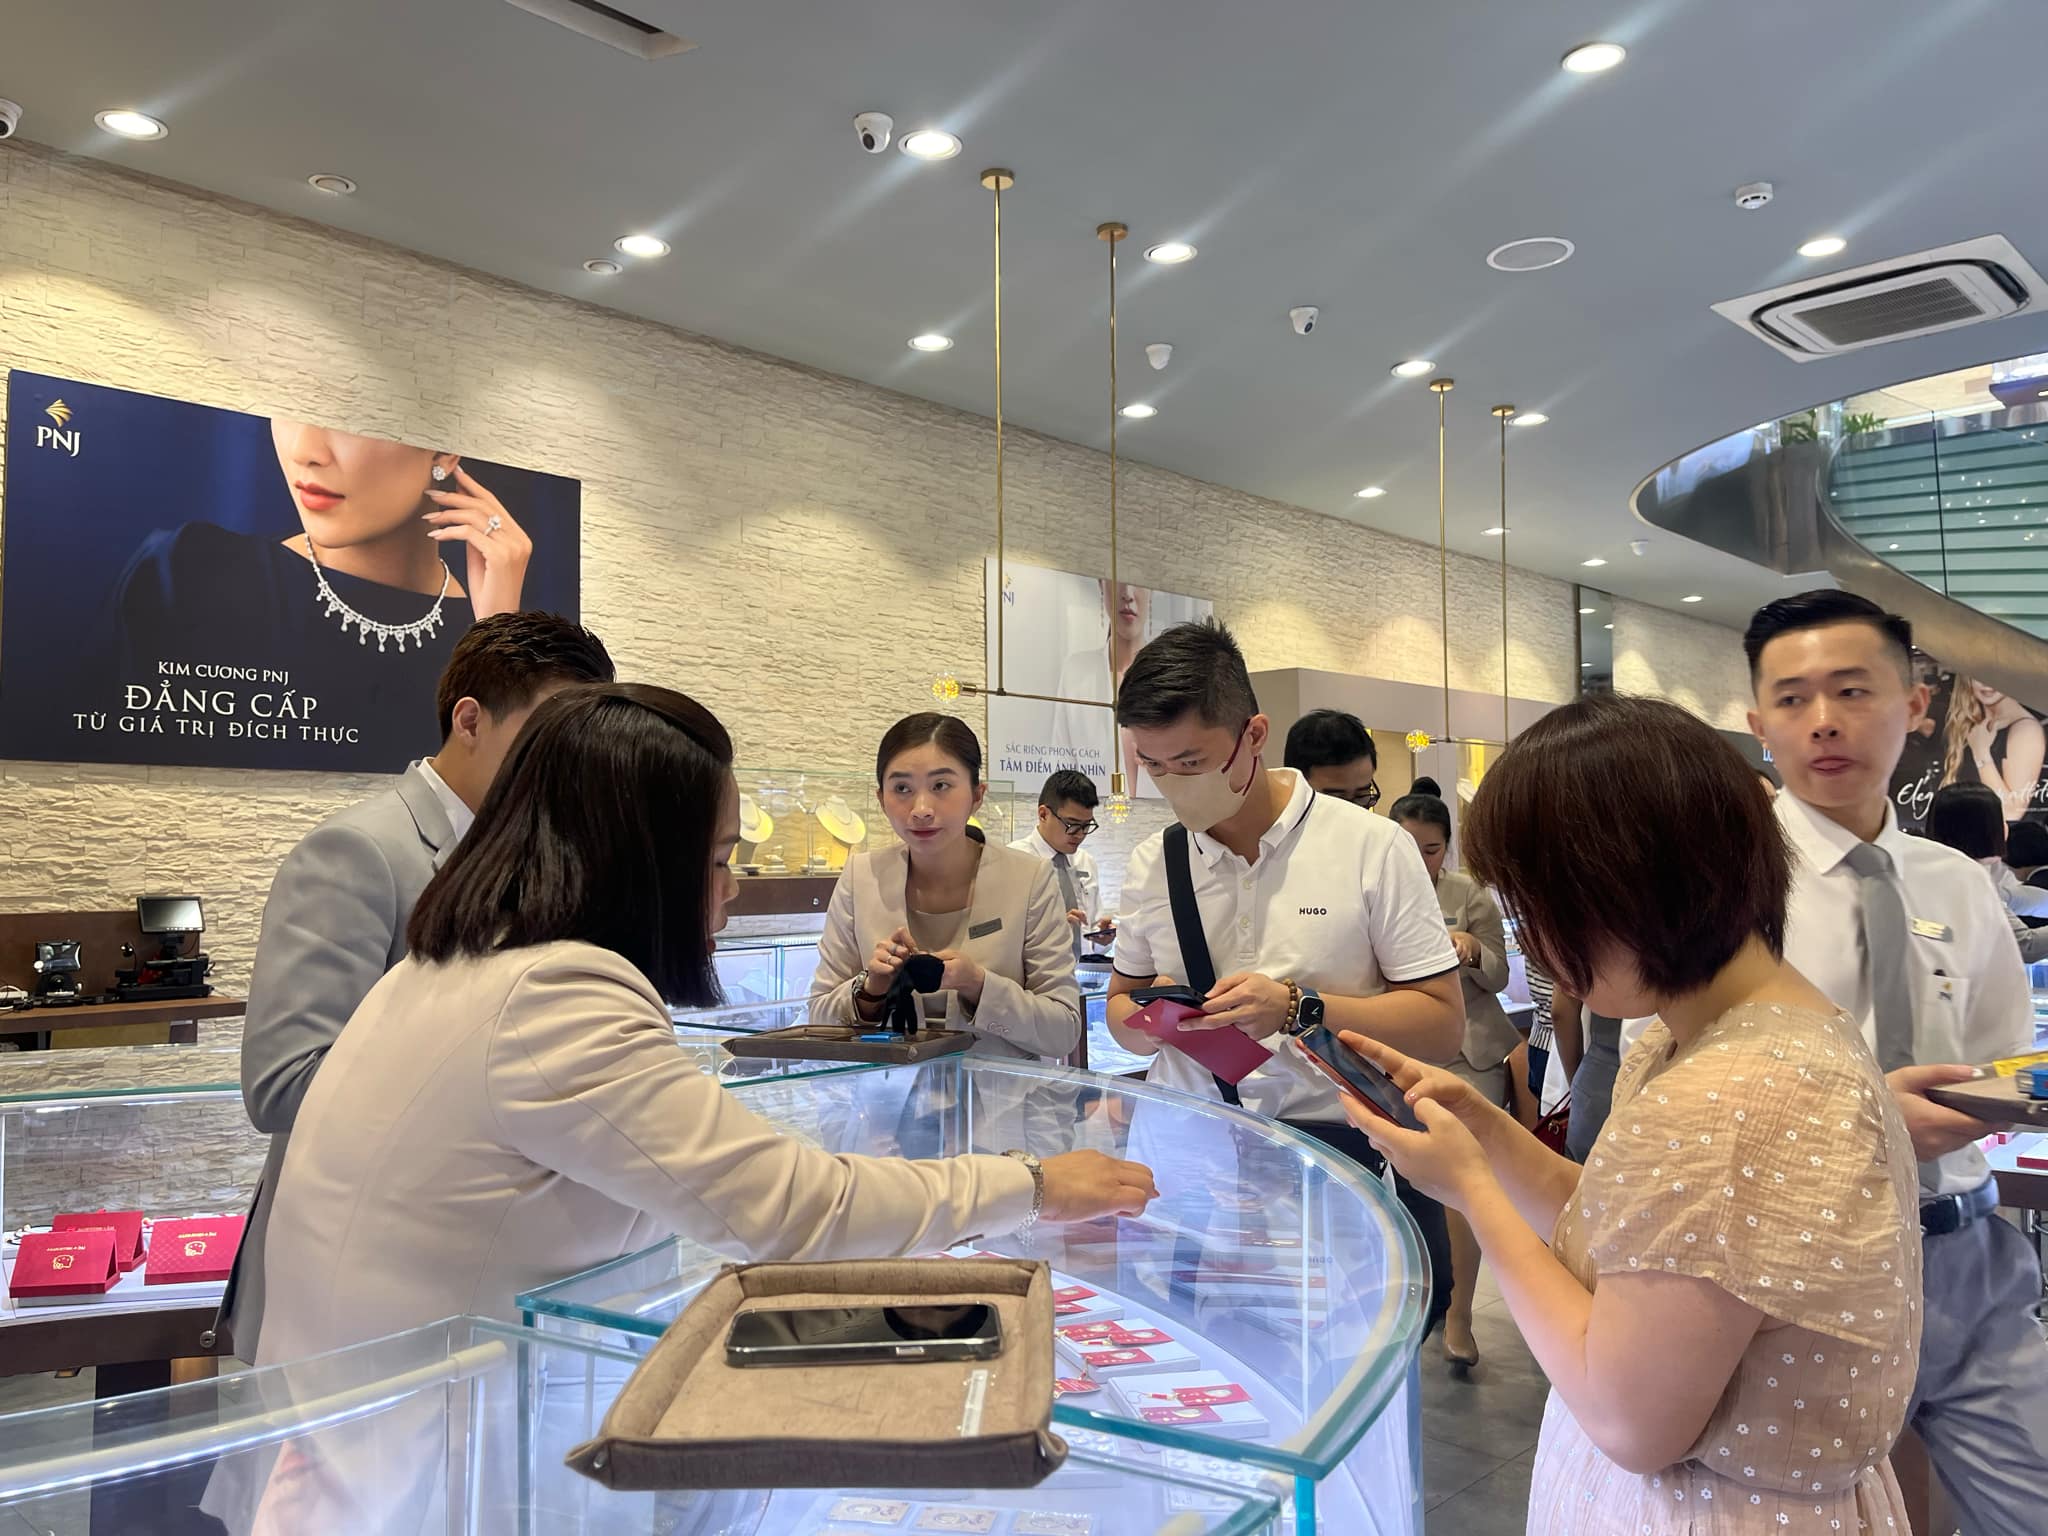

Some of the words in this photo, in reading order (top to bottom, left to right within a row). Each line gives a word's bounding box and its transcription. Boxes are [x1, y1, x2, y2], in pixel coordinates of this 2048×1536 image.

[36, 425, 81, 457] PNJ
[158, 661, 190, 676] KIM
[195, 663, 257, 681] CƯƠNG
[262, 669, 289, 686] PNJ
[124, 679, 236, 716] ĐẲNG
[250, 689, 318, 720] CẤP
[73, 711, 107, 730] TỪ
[119, 714, 165, 734] GIÁ
[175, 718, 215, 738] TRỊ
[228, 719, 287, 740] ĐÍCH
[299, 725, 359, 744] THỰC
[1048, 746, 1078, 758] PHONG
[1897, 777, 1935, 820] Eleg
[1299, 907, 1328, 916] HUGO
